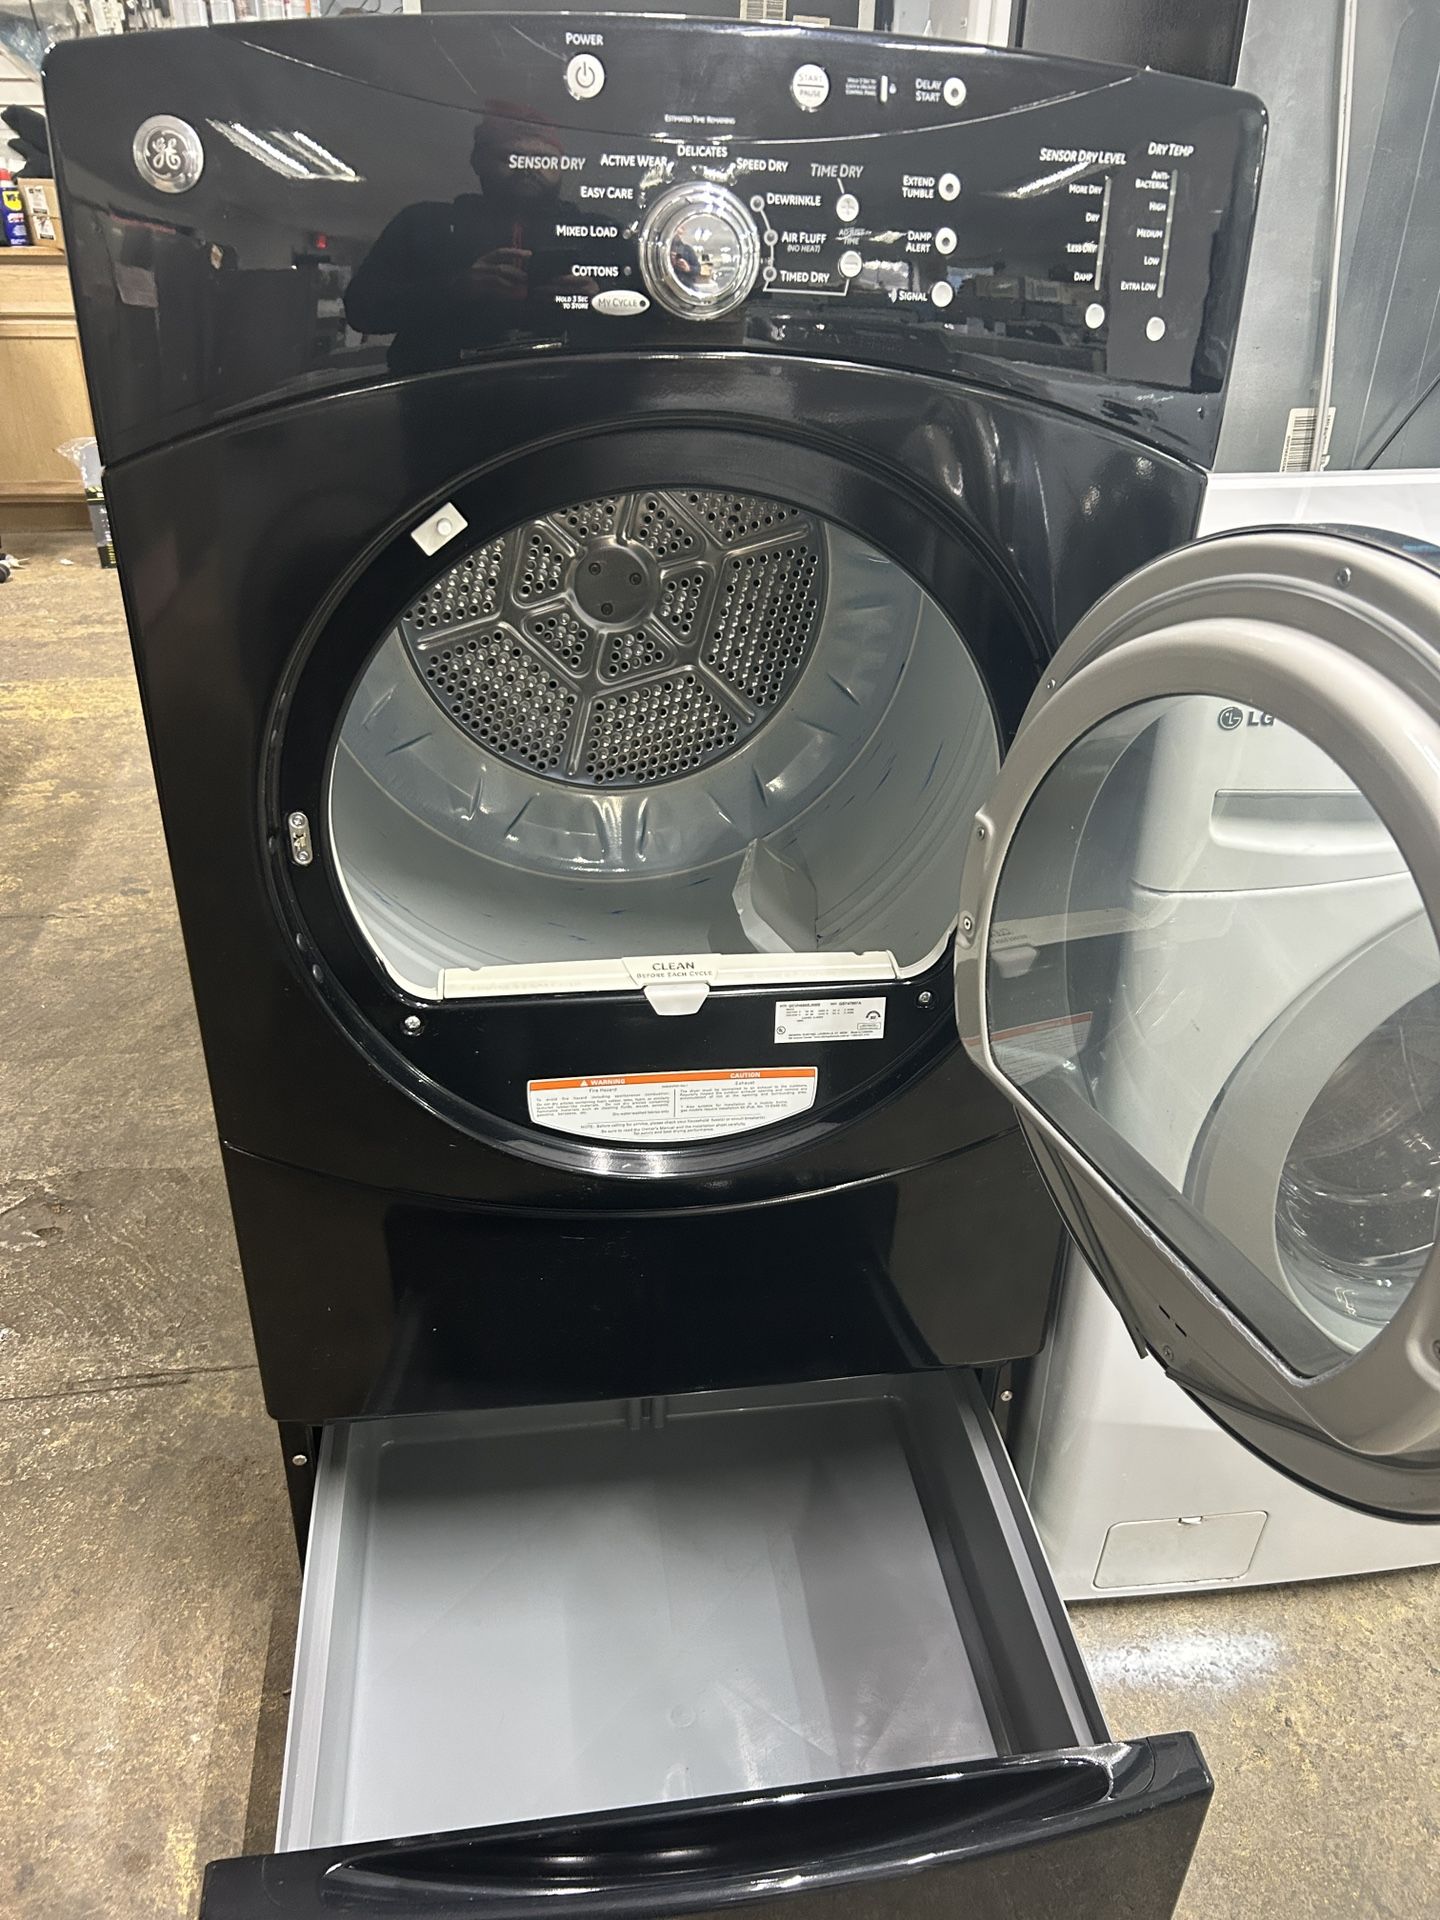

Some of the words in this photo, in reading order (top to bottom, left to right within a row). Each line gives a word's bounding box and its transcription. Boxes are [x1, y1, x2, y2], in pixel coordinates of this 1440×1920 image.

[565, 32, 604, 46] POWER
[798, 74, 823, 82] START
[915, 78, 942, 89] DELAY
[798, 89, 821, 98] PAUSE
[915, 91, 941, 102] START
[664, 114, 692, 123] ESTIMATED
[693, 115, 705, 123] TIME
[677, 145, 728, 158] DELICATES
[1147, 142, 1167, 156] DRY
[1167, 143, 1195, 157] TEMP
[600, 154, 635, 167] ACTIVE
[636, 155, 667, 168] WEAR
[1039, 148, 1077, 162] SENSOR
[1077, 150, 1098, 163] DRY
[1098, 151, 1127, 165] LEVEL
[509, 154, 558, 170] SENSOR
[561, 156, 586, 171] DRY
[736, 157, 766, 171] SPEED
[767, 159, 789, 172] DRY
[810, 163, 838, 178] TIME
[839, 164, 864, 179] DRY
[1151, 170, 1170, 180] ANTI-
[903, 175, 935, 187] EXTEND
[1135, 179, 1169, 190] BACTERIAL
[580, 186, 606, 199] EASY
[607, 187, 634, 200] CARE
[902, 187, 935, 199] TUMBLE
[1068, 184, 1088, 194] MORE
[1088, 185, 1103, 195] DRY
[766, 192, 821, 207] DEWRINKLE
[1148, 202, 1167, 212] HIGH
[1085, 212, 1100, 222] DRY
[556, 224, 588, 237] MIXED
[590, 225, 618, 238] LOAD
[907, 230, 933, 242] DAMP
[1136, 228, 1163, 239] MEDIUM
[781, 231, 800, 243] AIR
[800, 231, 827, 244] FLUFF
[787, 244, 800, 253] (NO
[801, 245, 821, 253] HEAT)
[905, 242, 931, 253] ALERT
[1066, 243, 1082, 253] LESS
[1083, 242, 1098, 253] DRY
[1143, 256, 1160, 266] LOW
[571, 264, 619, 277] COTTONS
[780, 270, 809, 283] TIMED
[810, 271, 830, 284] DRY
[1073, 272, 1093, 282] DAMP
[1120, 281, 1141, 291] EXTRA
[1141, 282, 1157, 292] LOW
[555, 295, 571, 303] HOLD
[572, 295, 577, 303] 3
[898, 291, 928, 302] SIGNAL
[598, 298, 612, 308] MY
[612, 297, 638, 308] CYCLE
[652, 961, 695, 971] CLEAN
[730, 1071, 761, 1079] CAUTION
[590, 1078, 626, 1086] WARNING
